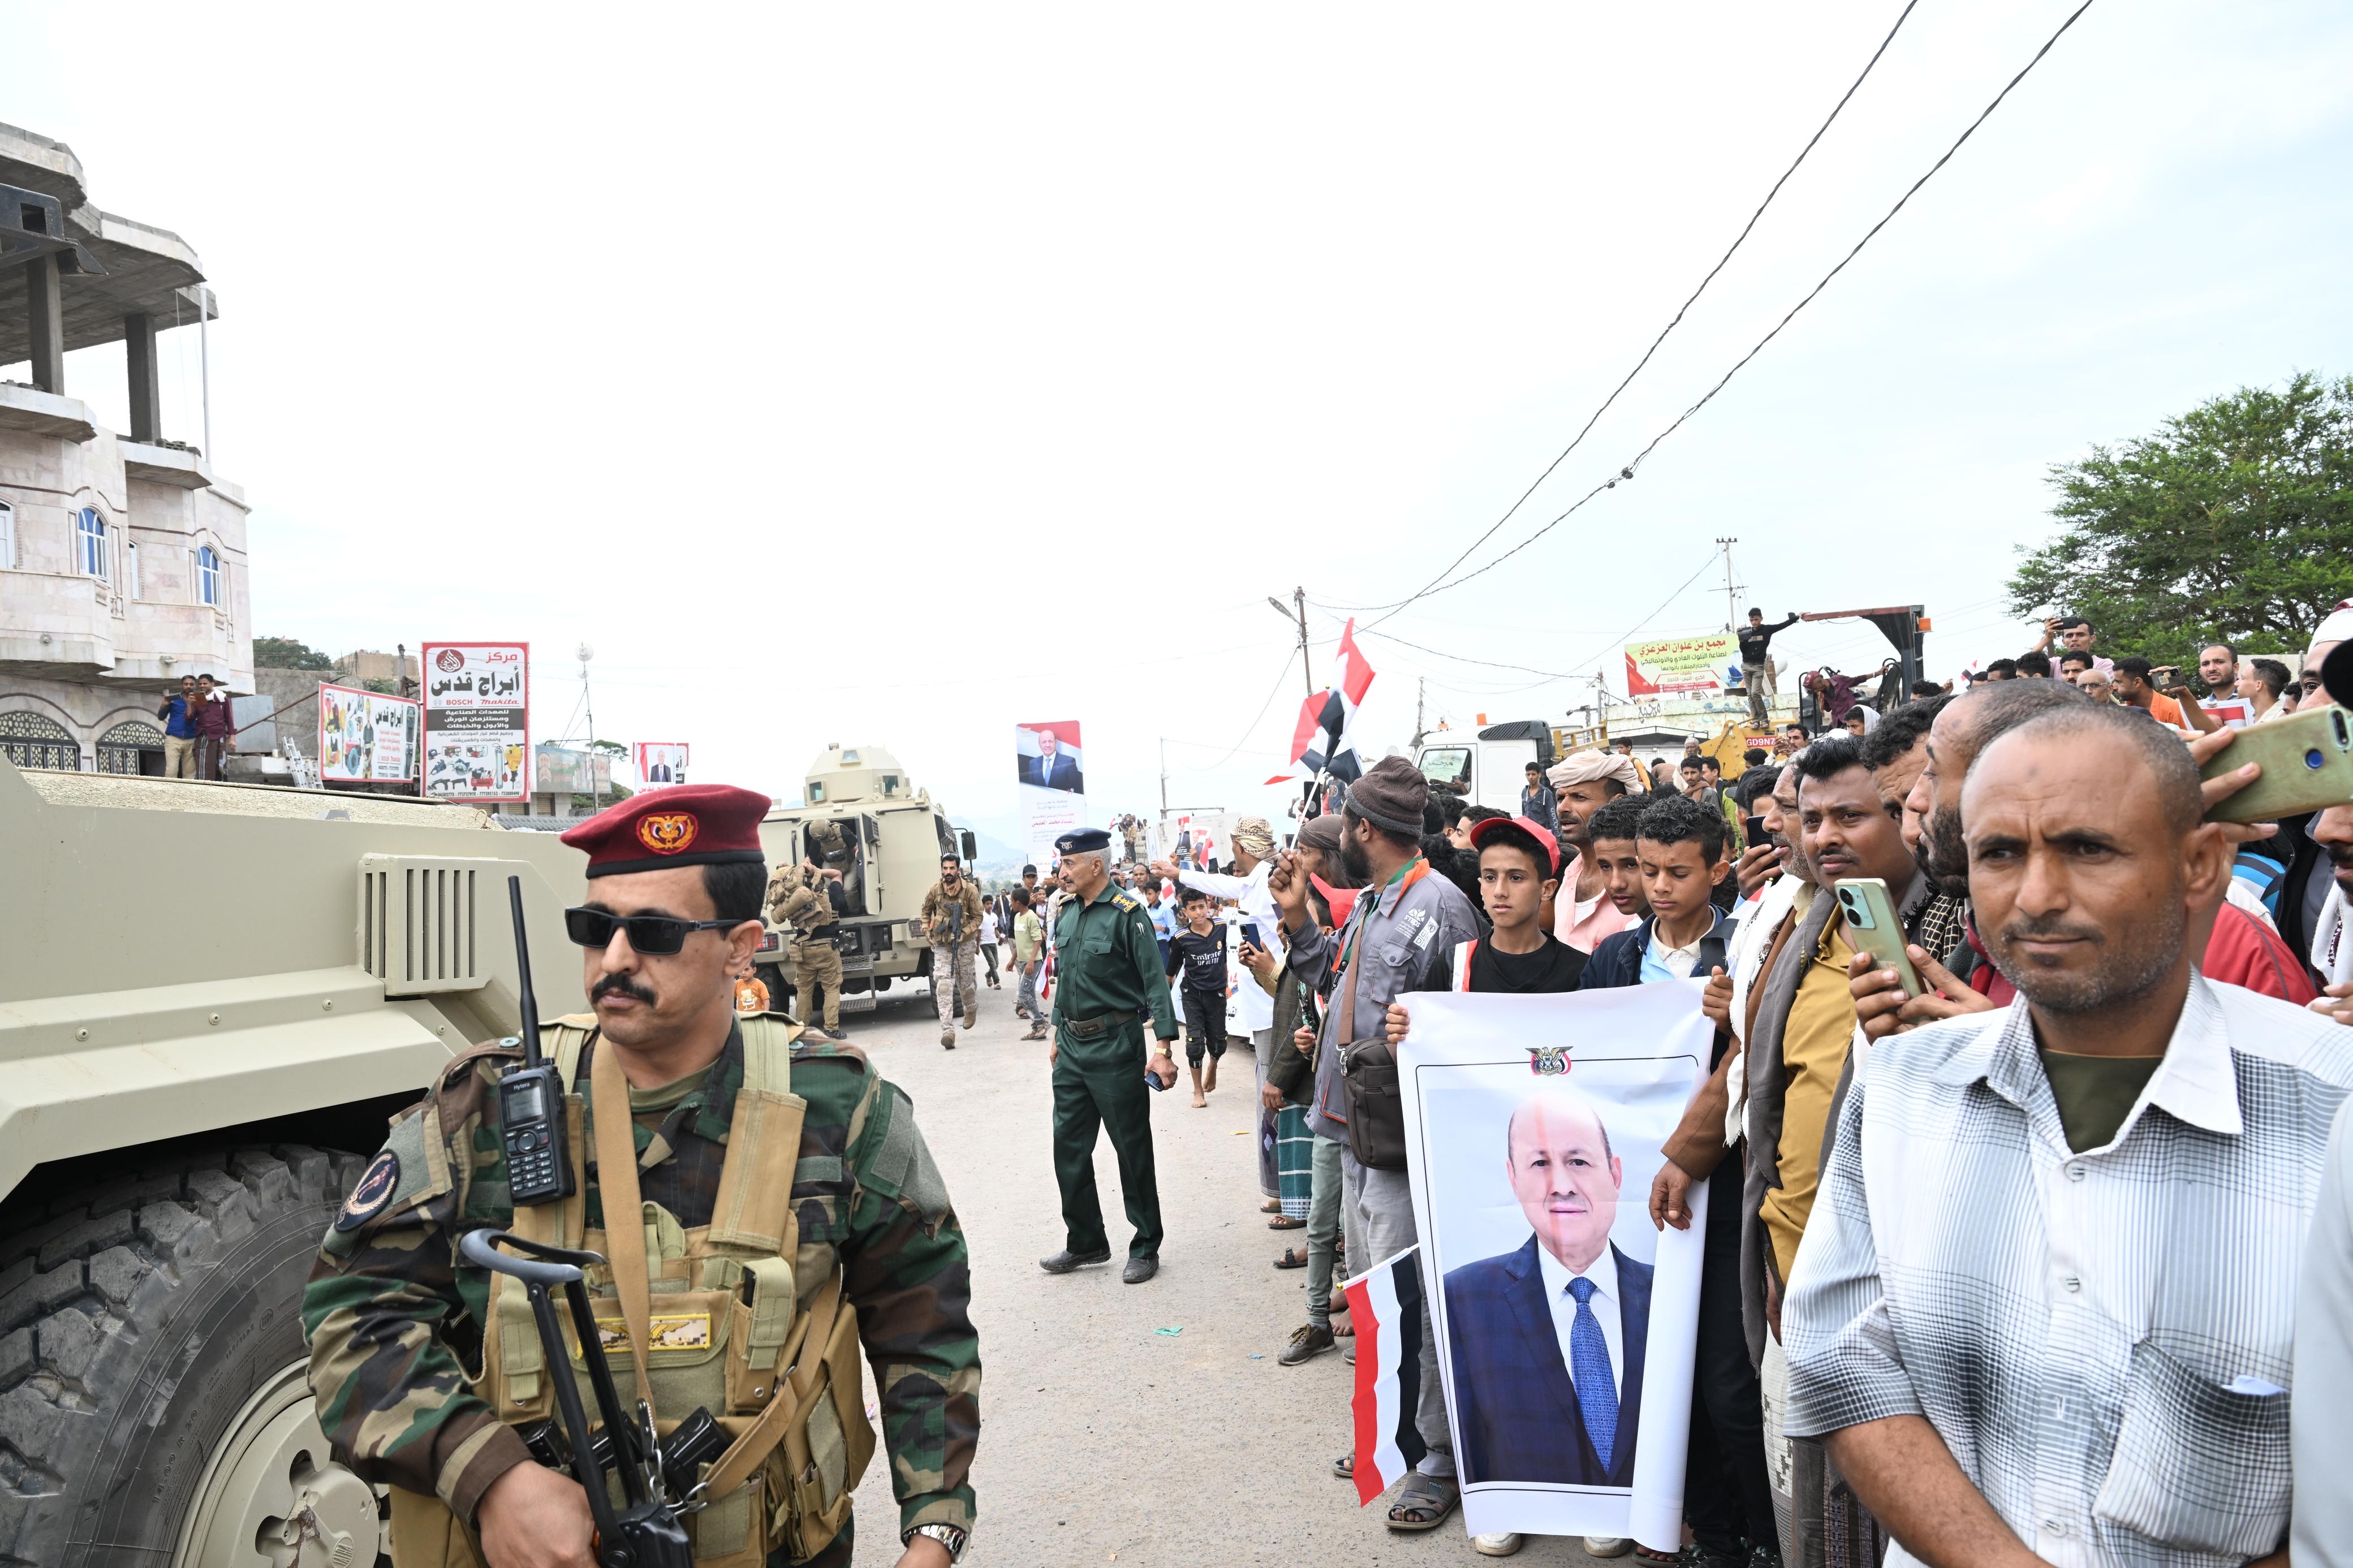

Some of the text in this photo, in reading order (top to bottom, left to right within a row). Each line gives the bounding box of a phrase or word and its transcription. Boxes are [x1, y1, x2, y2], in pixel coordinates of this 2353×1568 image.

[1673, 641, 1692, 653] علوان
[1694, 640, 1704, 651] بن
[1706, 640, 1726, 650] مجمع
[486, 652, 518, 663] مركز
[1674, 654, 1690, 663] العادي
[431, 665, 520, 697] أبراج قدس
[375, 704, 403, 728] أبراج قدس
[1191, 950, 1222, 960] Emirate
[514, 1082, 530, 1091] Hytera
[152, 1452, 176, 1504] 14.00
[176, 1435, 185, 1448] R
[184, 1409, 198, 1432] 20
[333, 1543, 354, 1566] TATRA
